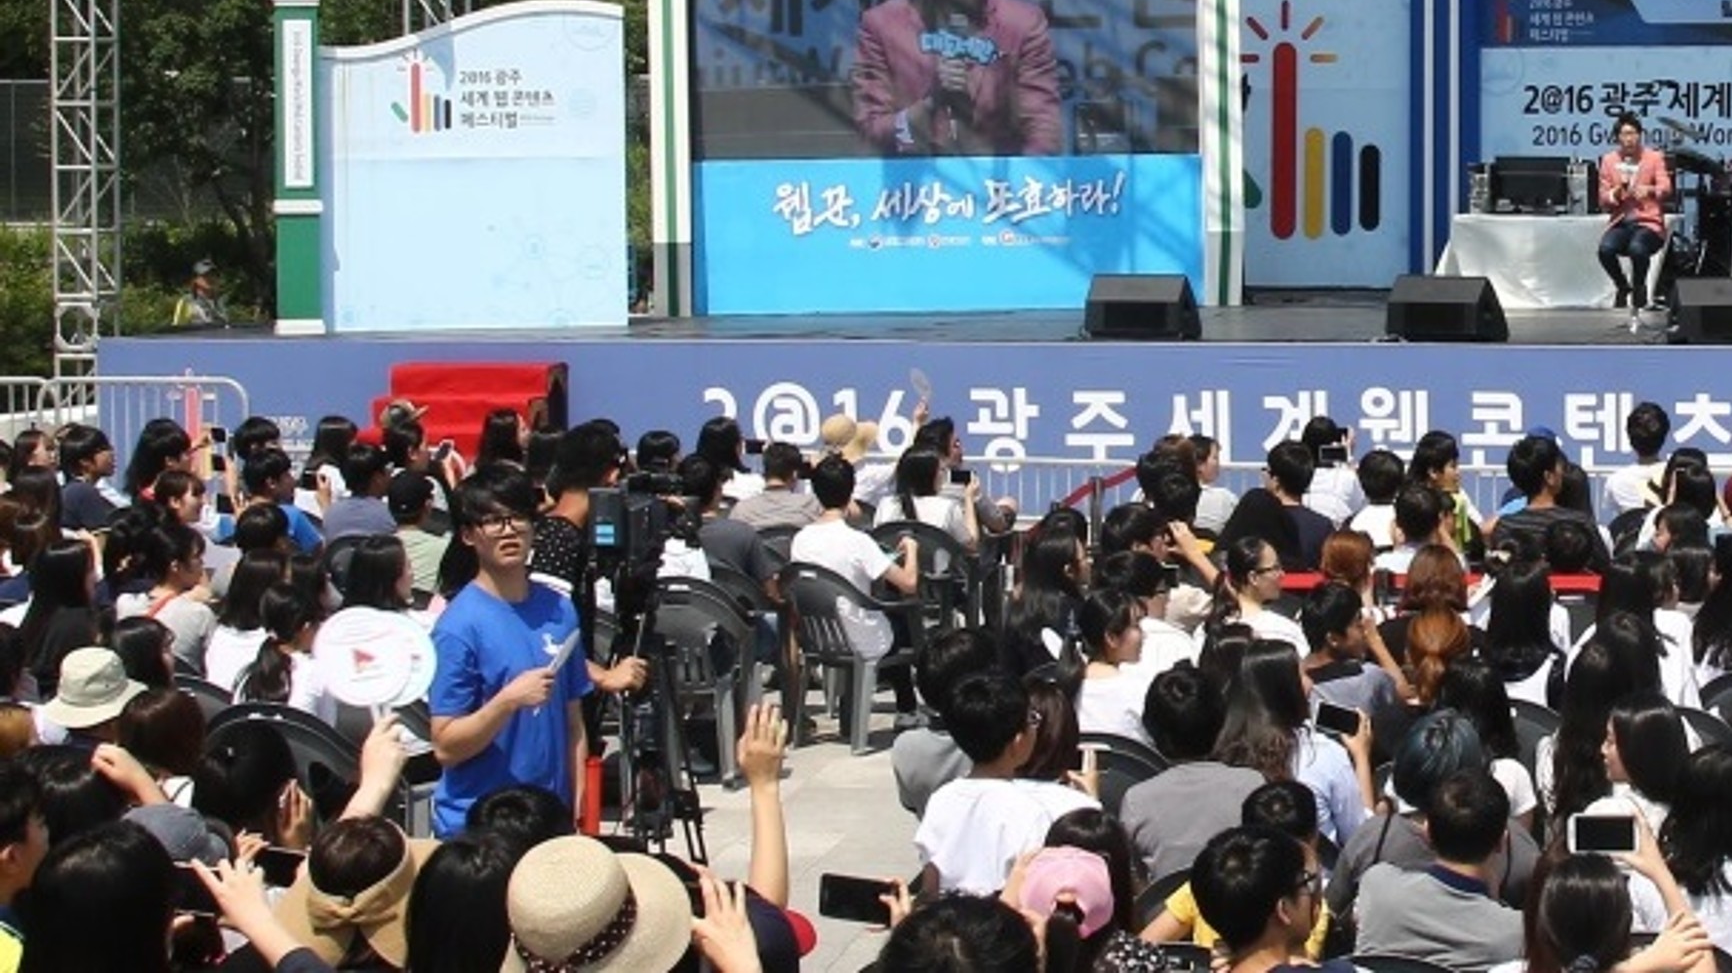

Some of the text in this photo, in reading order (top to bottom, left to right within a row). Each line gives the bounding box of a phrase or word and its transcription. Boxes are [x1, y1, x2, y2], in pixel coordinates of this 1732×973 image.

[459, 70, 492, 84] 2016
[1523, 85, 1594, 114] 2@16
[1600, 82, 1662, 118] 광주
[1668, 82, 1732, 118] 세계
[460, 111, 518, 129] 페스티벌
[1532, 125, 1582, 147] 2016
[870, 181, 974, 225] 세상에
